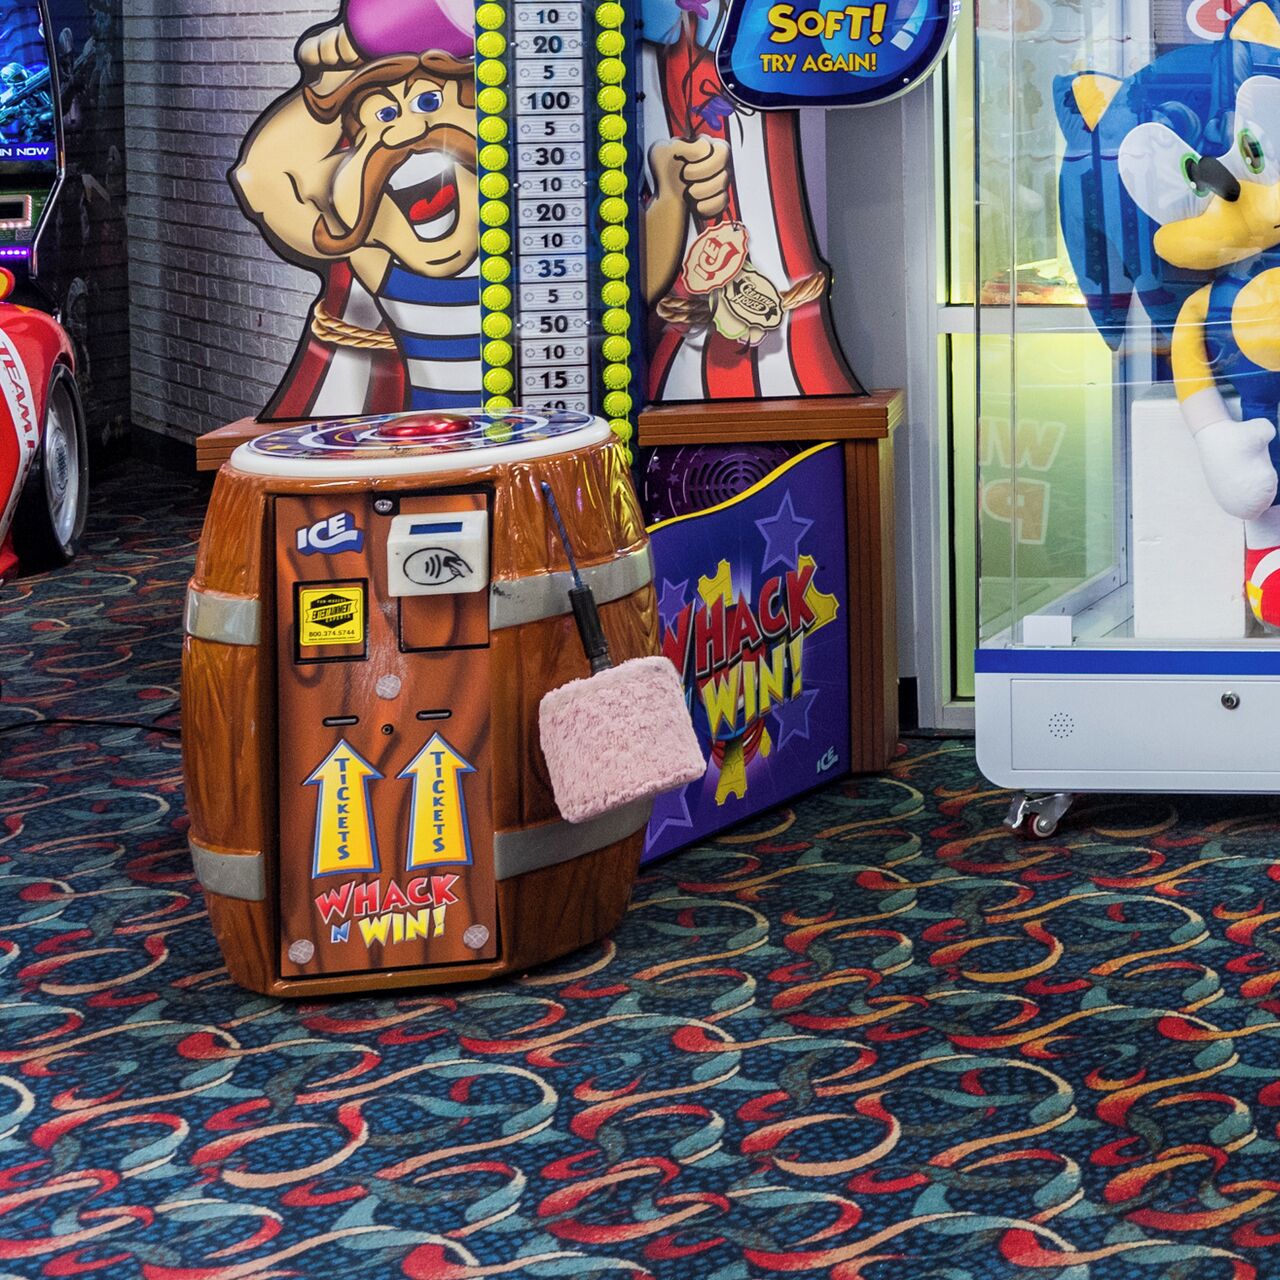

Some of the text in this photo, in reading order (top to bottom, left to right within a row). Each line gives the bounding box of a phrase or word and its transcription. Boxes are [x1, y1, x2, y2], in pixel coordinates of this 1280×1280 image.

[536, 9, 558, 24] 10
[767, 3, 888, 46] SOFT!
[533, 35, 563, 53] 20
[760, 52, 877, 73] TRY AGAIN!
[543, 65, 554, 79] 5
[527, 91, 570, 109] 100
[545, 122, 555, 136] 5
[16, 147, 49, 156] NOW
[535, 147, 564, 165] 30
[540, 177, 562, 191] 10
[537, 203, 565, 221] 20
[540, 233, 563, 247] 10
[537, 259, 566, 277] 35
[693, 237, 732, 281] ICE
[547, 289, 558, 303] 5
[732, 293, 767, 312] HOUSE
[540, 315, 568, 333] 50
[543, 345, 565, 359] 10
[540, 371, 568, 389] 15
[297, 512, 358, 550] ICE
[312, 602, 352, 620] ENTERTAINMENT
[308, 629, 355, 637] 800.374.5744
[701, 632, 804, 744] WIN!
[816, 745, 839, 774] ICE
[334, 758, 350, 861] TICKETS
[430, 751, 446, 853] TICKETS
[315, 874, 460, 924] WHACK
[331, 904, 446, 949] N WIN!
